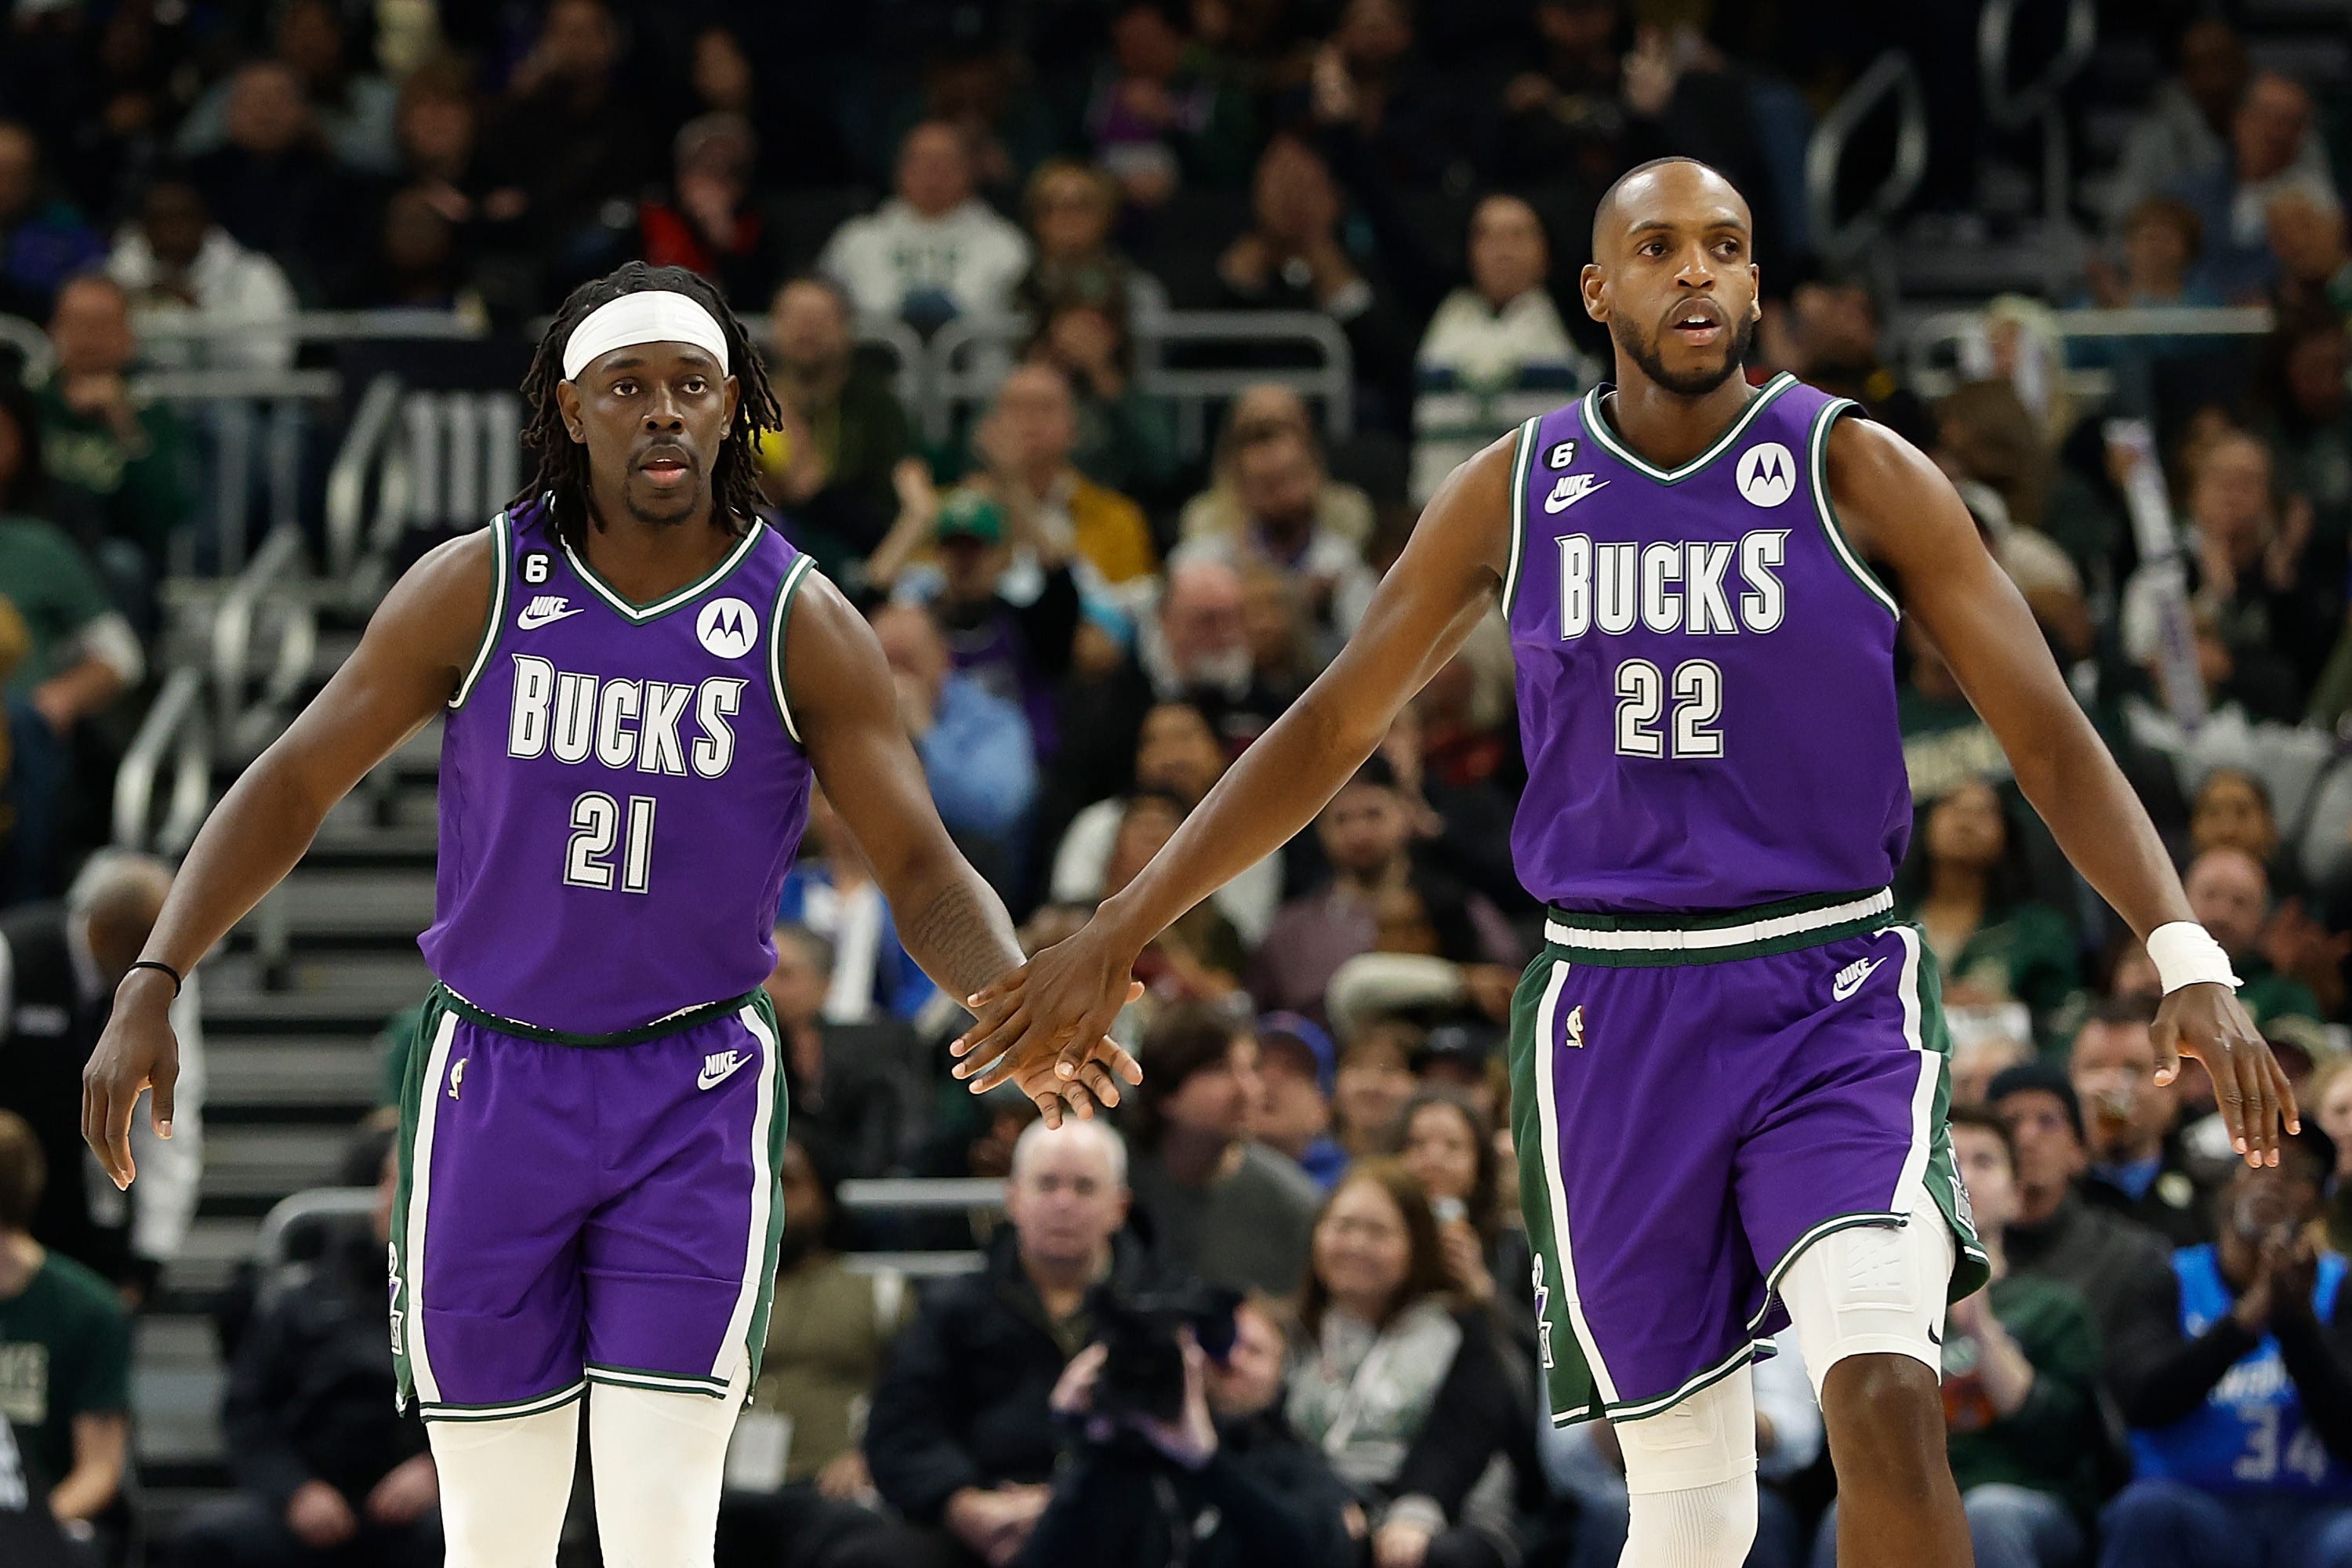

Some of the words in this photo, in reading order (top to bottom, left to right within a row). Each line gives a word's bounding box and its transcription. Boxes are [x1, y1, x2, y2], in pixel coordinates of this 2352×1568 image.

[1550, 441, 1575, 469] 6
[1553, 474, 1595, 499] NIKE
[525, 554, 549, 583] 6
[1553, 528, 1793, 641] BUCKS
[527, 596, 569, 616] NIKE
[507, 654, 750, 779] BUCKS
[1614, 658, 1724, 759] 22
[563, 791, 656, 894] 21
[1835, 956, 1870, 989] NIKE
[705, 1050, 739, 1076] NIKE
